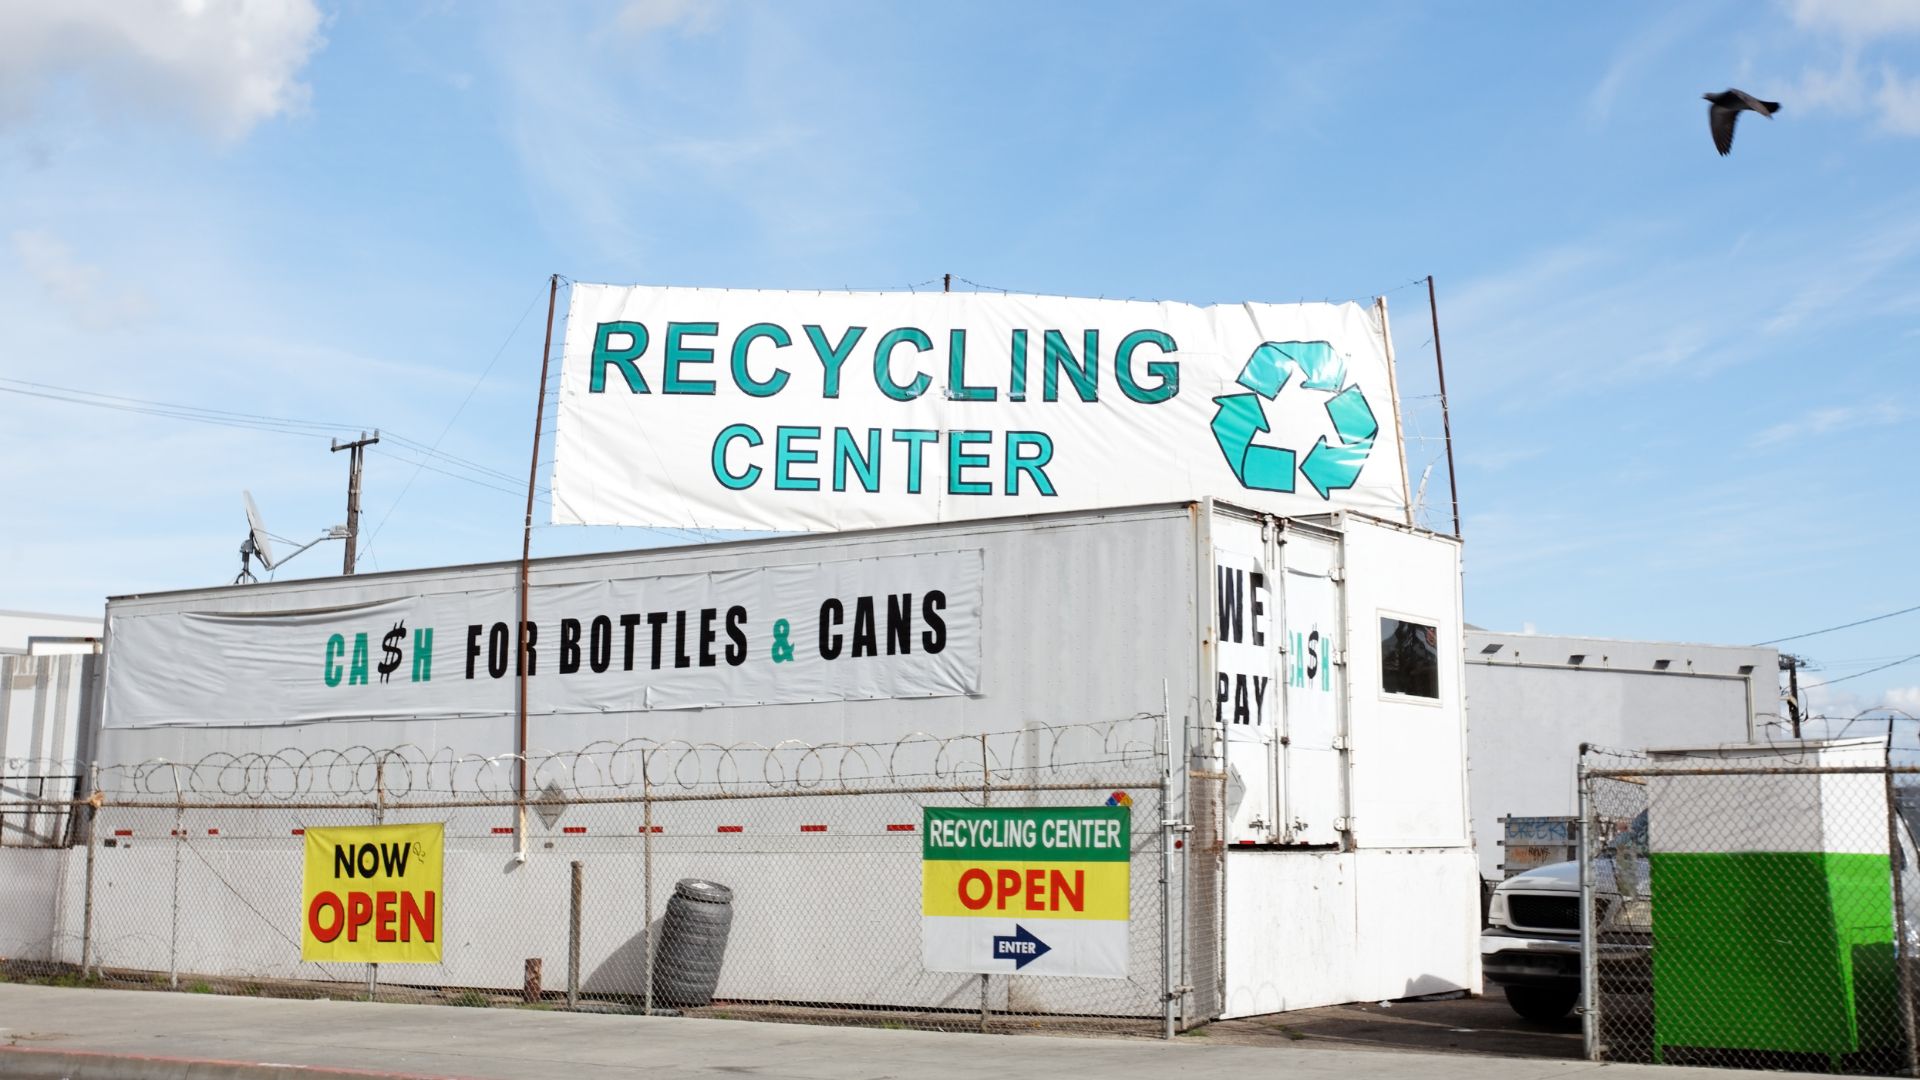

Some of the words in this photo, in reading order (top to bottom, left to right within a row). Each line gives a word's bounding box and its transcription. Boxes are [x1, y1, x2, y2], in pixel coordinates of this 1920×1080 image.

[589, 321, 1180, 404] RECYCLING
[712, 424, 1058, 497] CENTER
[1218, 565, 1264, 646] WE
[324, 620, 432, 686] CA$H
[466, 621, 537, 679] FOR
[559, 605, 747, 674] BOTTLES
[772, 618, 794, 663] &
[820, 590, 947, 662] CANS
[1216, 672, 1268, 726] PAY
[335, 842, 411, 878] NOW
[930, 819, 1036, 848] RECYCLING
[1042, 820, 1121, 848] CENTER
[958, 868, 1084, 911] OPEN
[308, 891, 435, 943] OPEN
[999, 941, 1036, 954] ENTER
